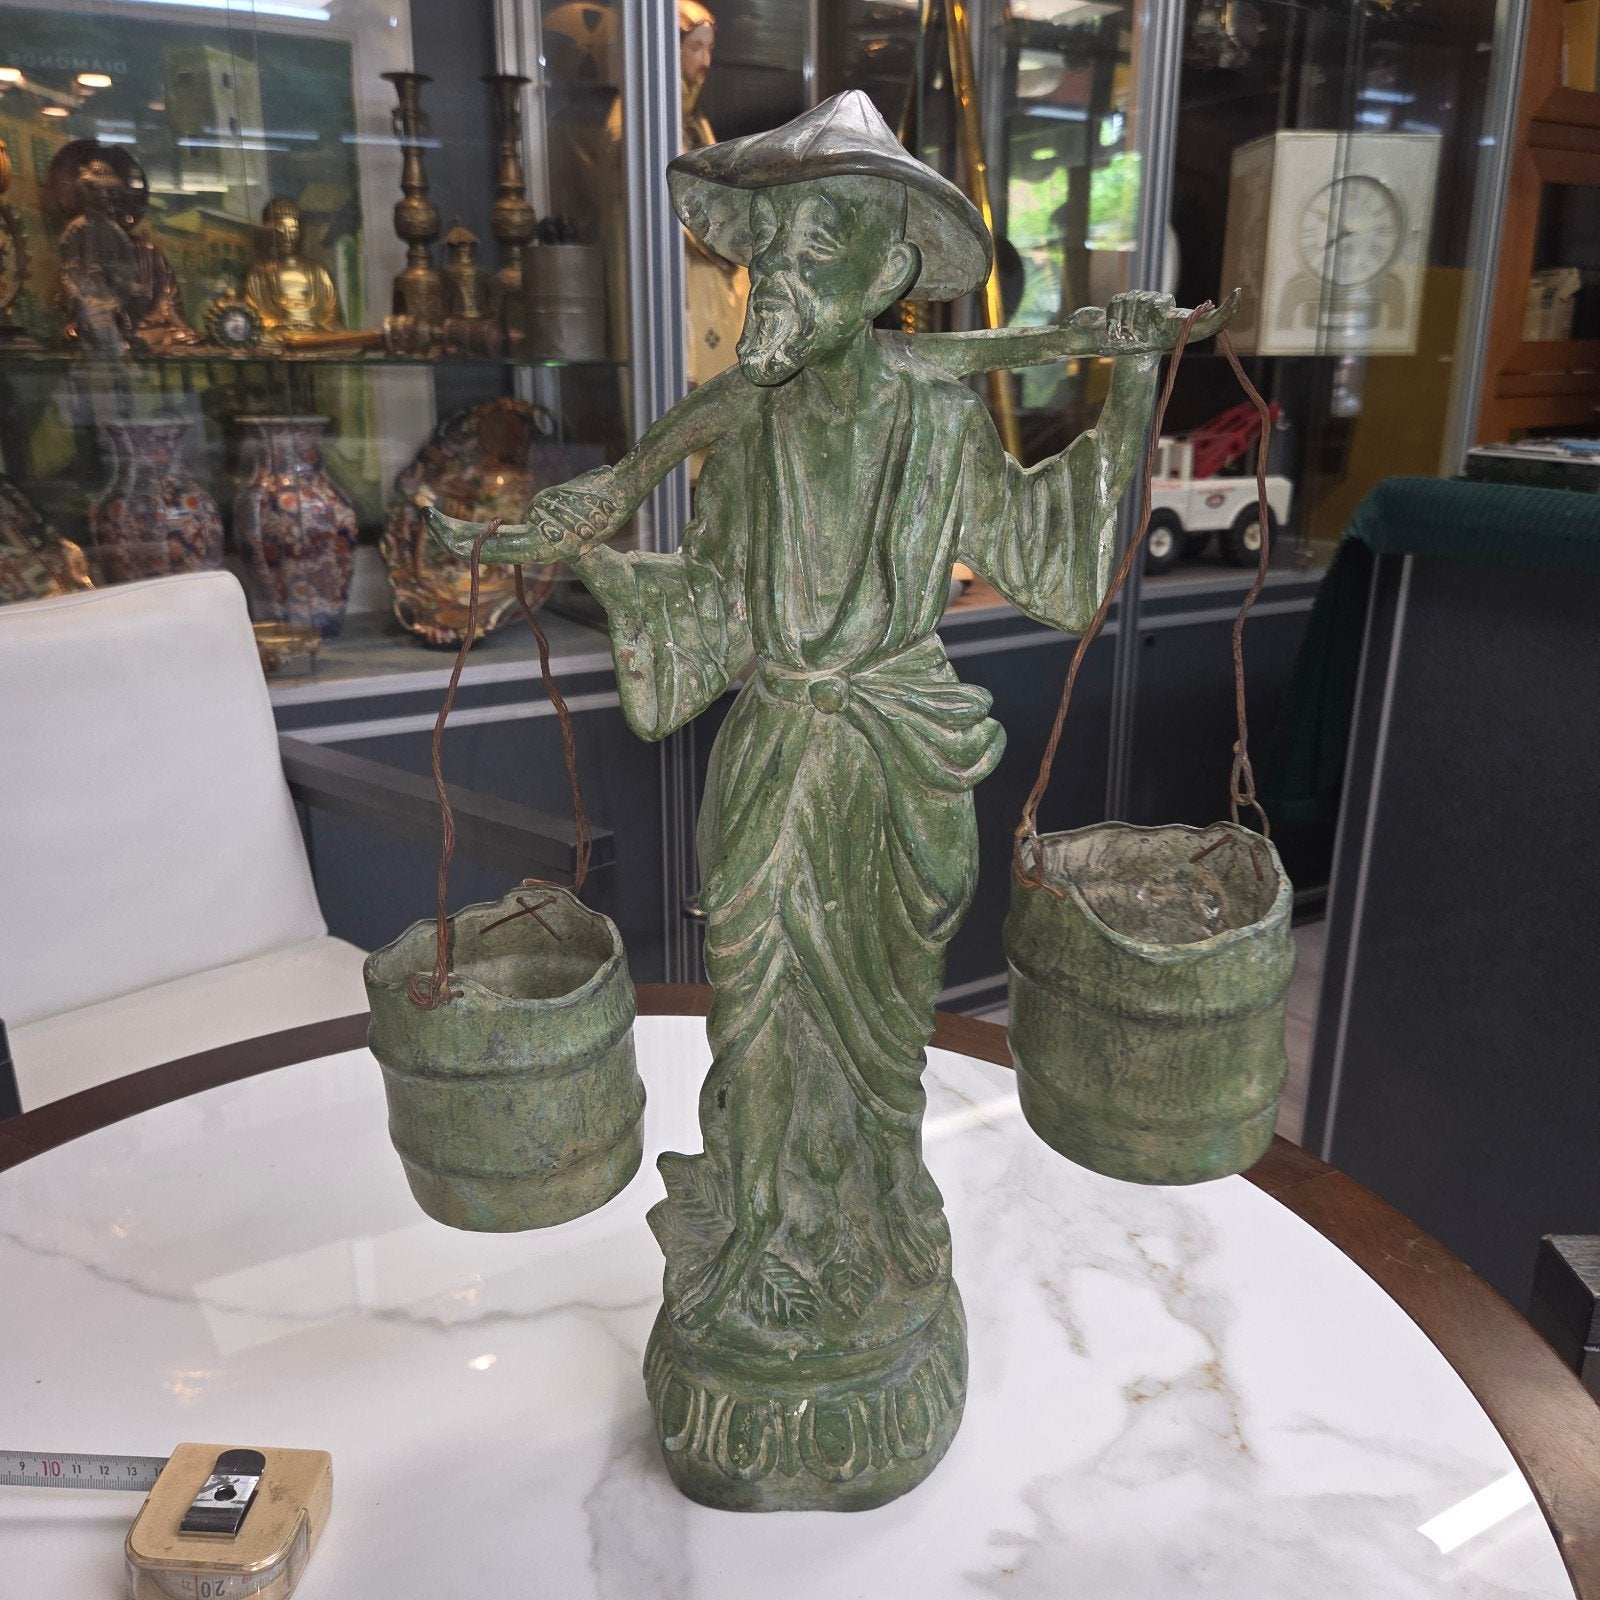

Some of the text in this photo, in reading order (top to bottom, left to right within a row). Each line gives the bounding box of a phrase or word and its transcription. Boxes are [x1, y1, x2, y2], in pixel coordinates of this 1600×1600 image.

[19, 1461, 26, 1471] 9
[42, 1460, 61, 1477] 10
[72, 1464, 82, 1474] 11
[99, 1465, 110, 1476] 12
[127, 1466, 137, 1476] 13
[200, 1580, 226, 1598] 20
